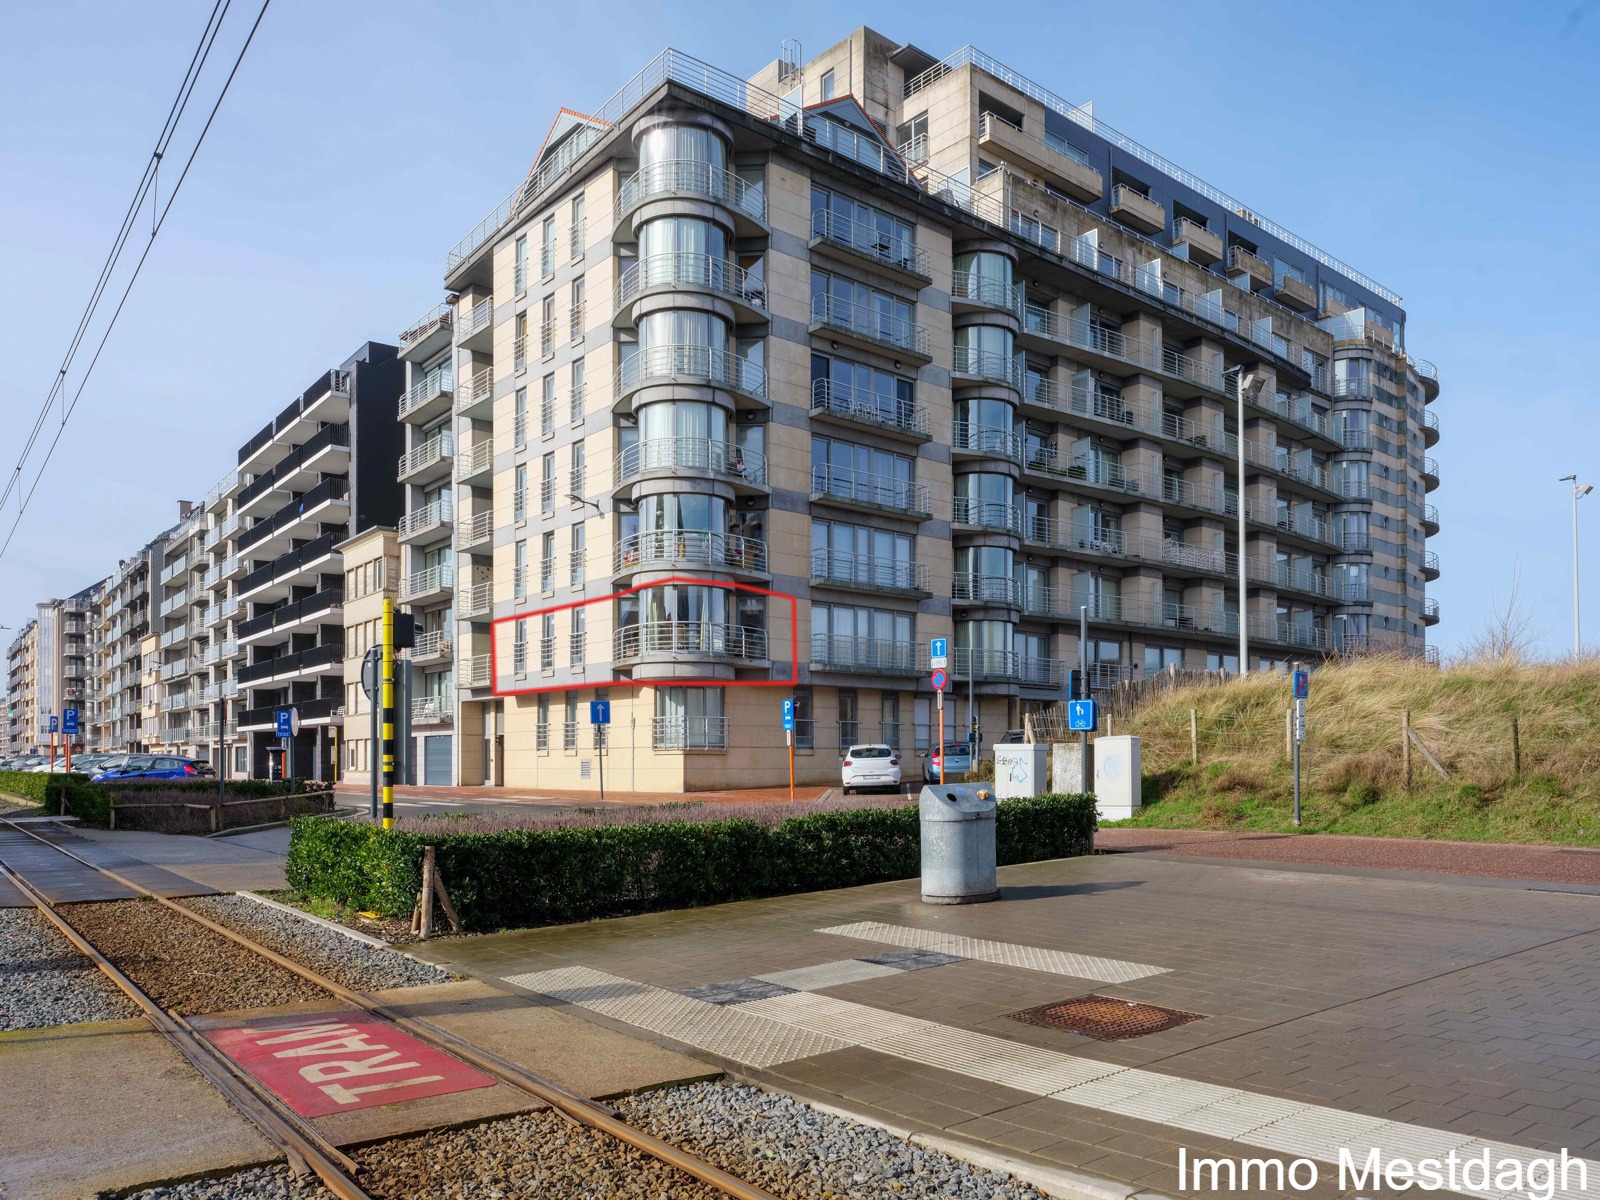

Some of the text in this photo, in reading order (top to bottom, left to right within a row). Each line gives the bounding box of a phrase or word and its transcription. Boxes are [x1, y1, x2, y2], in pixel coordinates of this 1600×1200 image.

[785, 701, 791, 713] P
[66, 710, 75, 720] P
[280, 712, 289, 723] P
[51, 718, 58, 730] P
[241, 1017, 445, 1104] TRAM
